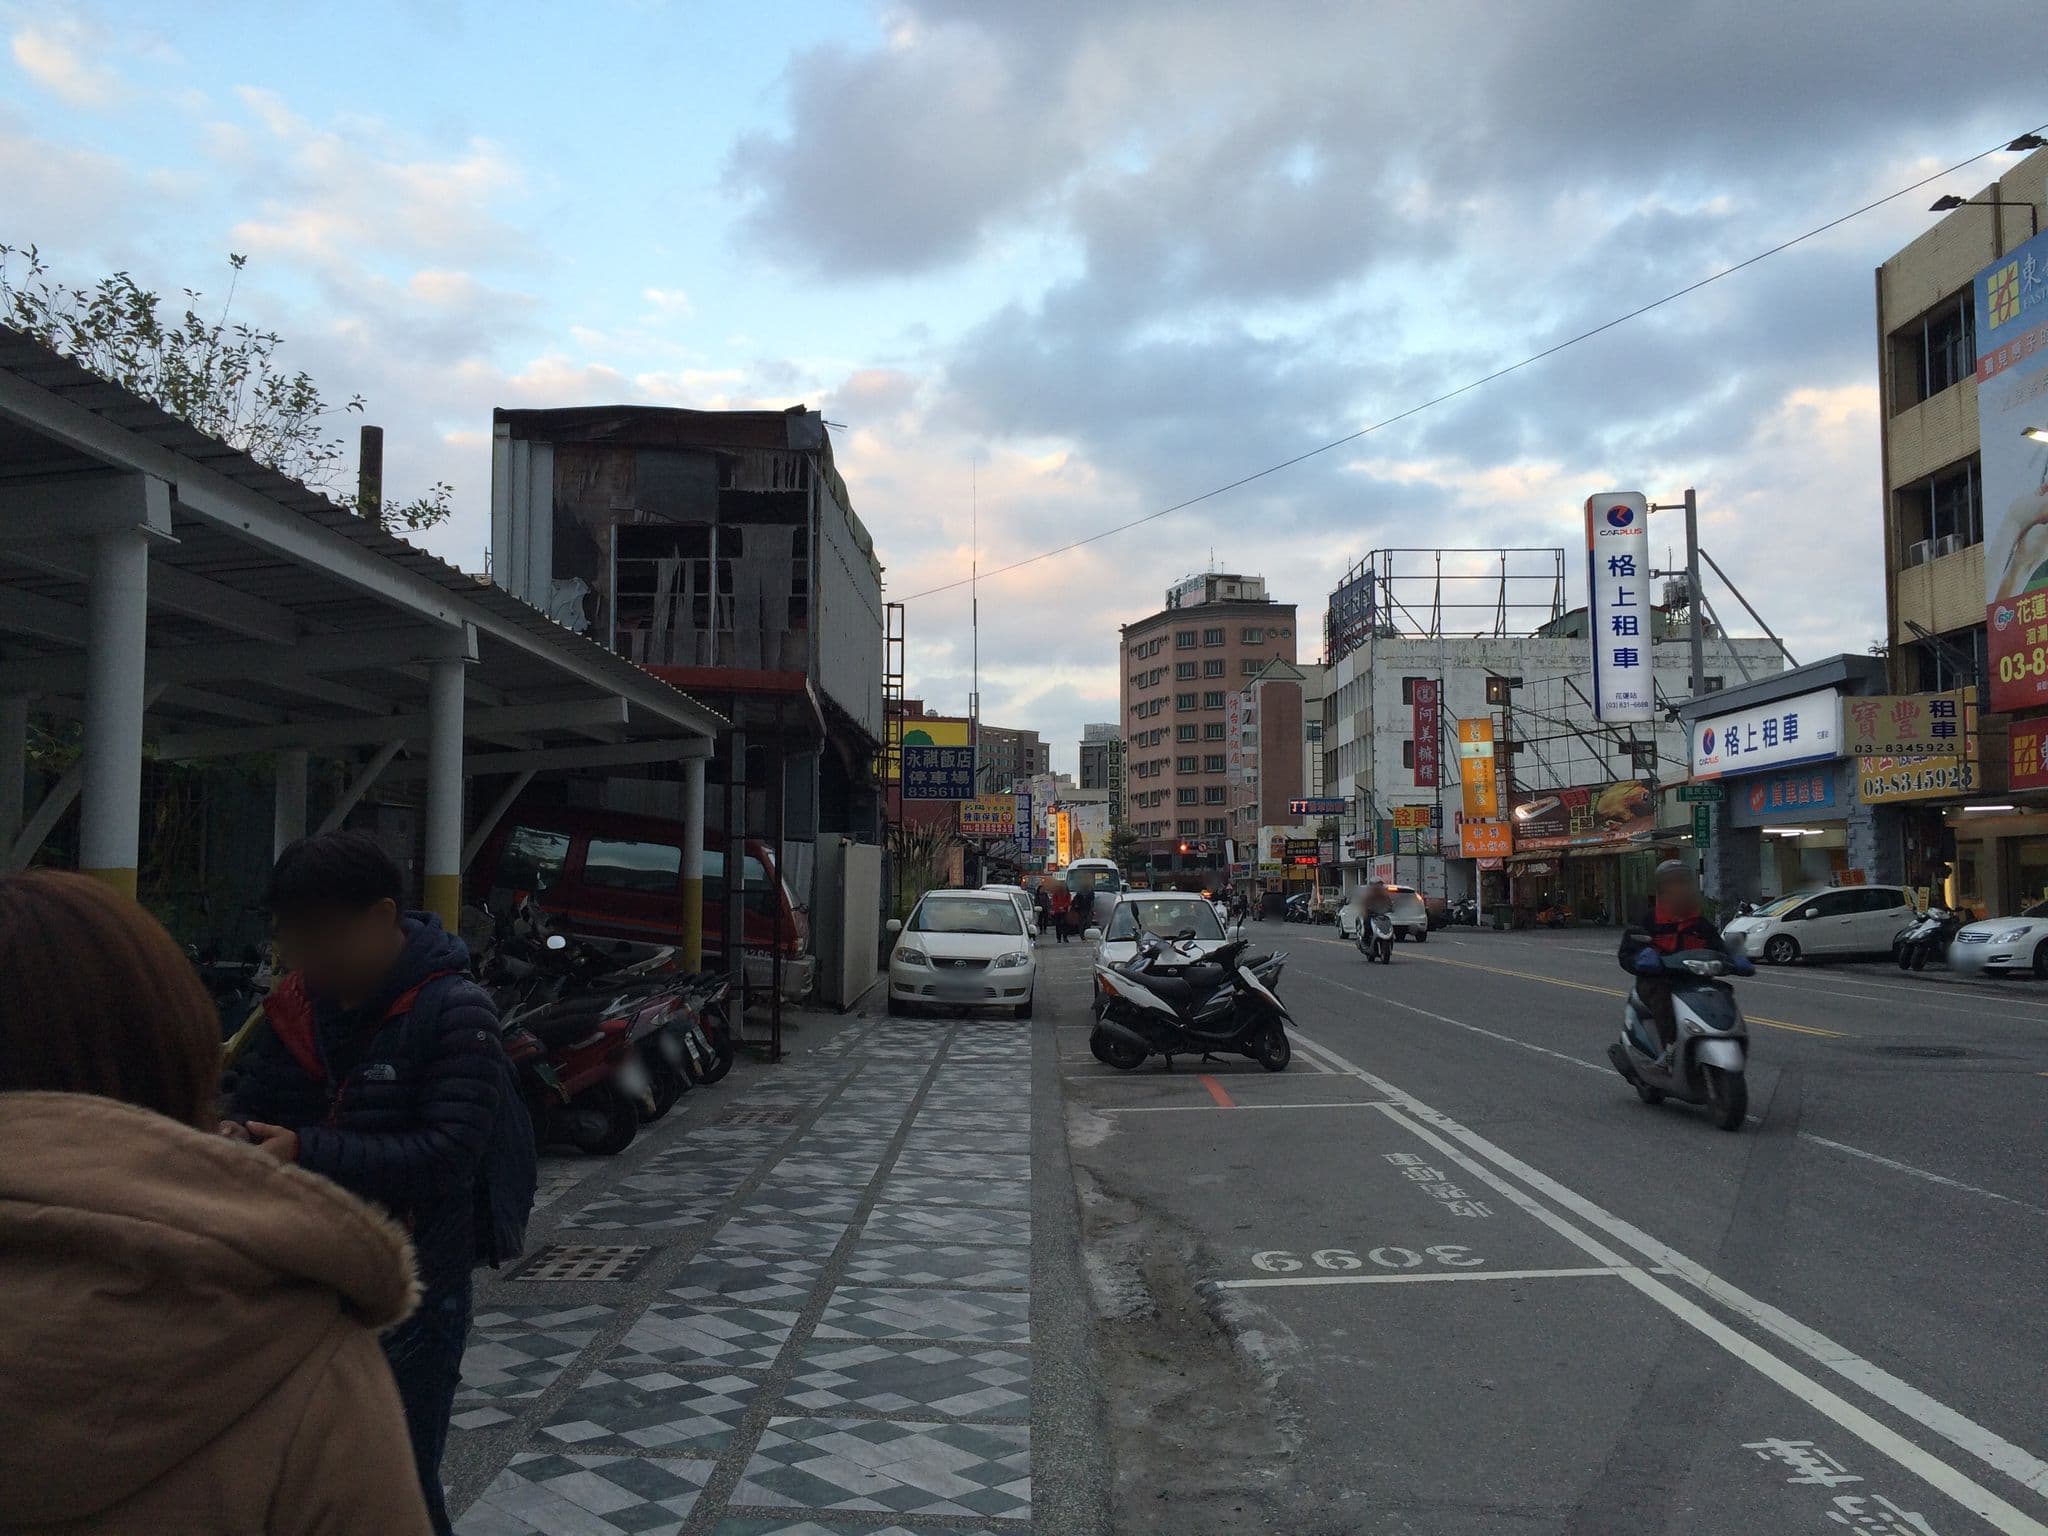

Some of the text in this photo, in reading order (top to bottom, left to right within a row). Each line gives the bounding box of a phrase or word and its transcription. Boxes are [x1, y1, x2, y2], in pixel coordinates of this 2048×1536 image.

[1600, 528, 1642, 536] CARPLUS
[1608, 554, 1639, 668] 格上租車
[2000, 648, 2048, 683] 03-8
[1852, 701, 1919, 740] 寶豐
[1930, 700, 1957, 739] 租車
[1724, 713, 1798, 757] 格上租車
[1855, 743, 1955, 753] 03-8345923
[907, 749, 972, 768] 永祺飯店
[909, 771, 970, 785] 停車場
[1864, 763, 1973, 798] 03-8345923
[908, 787, 971, 797] 8356111
[1395, 808, 1429, 827] 詮興
